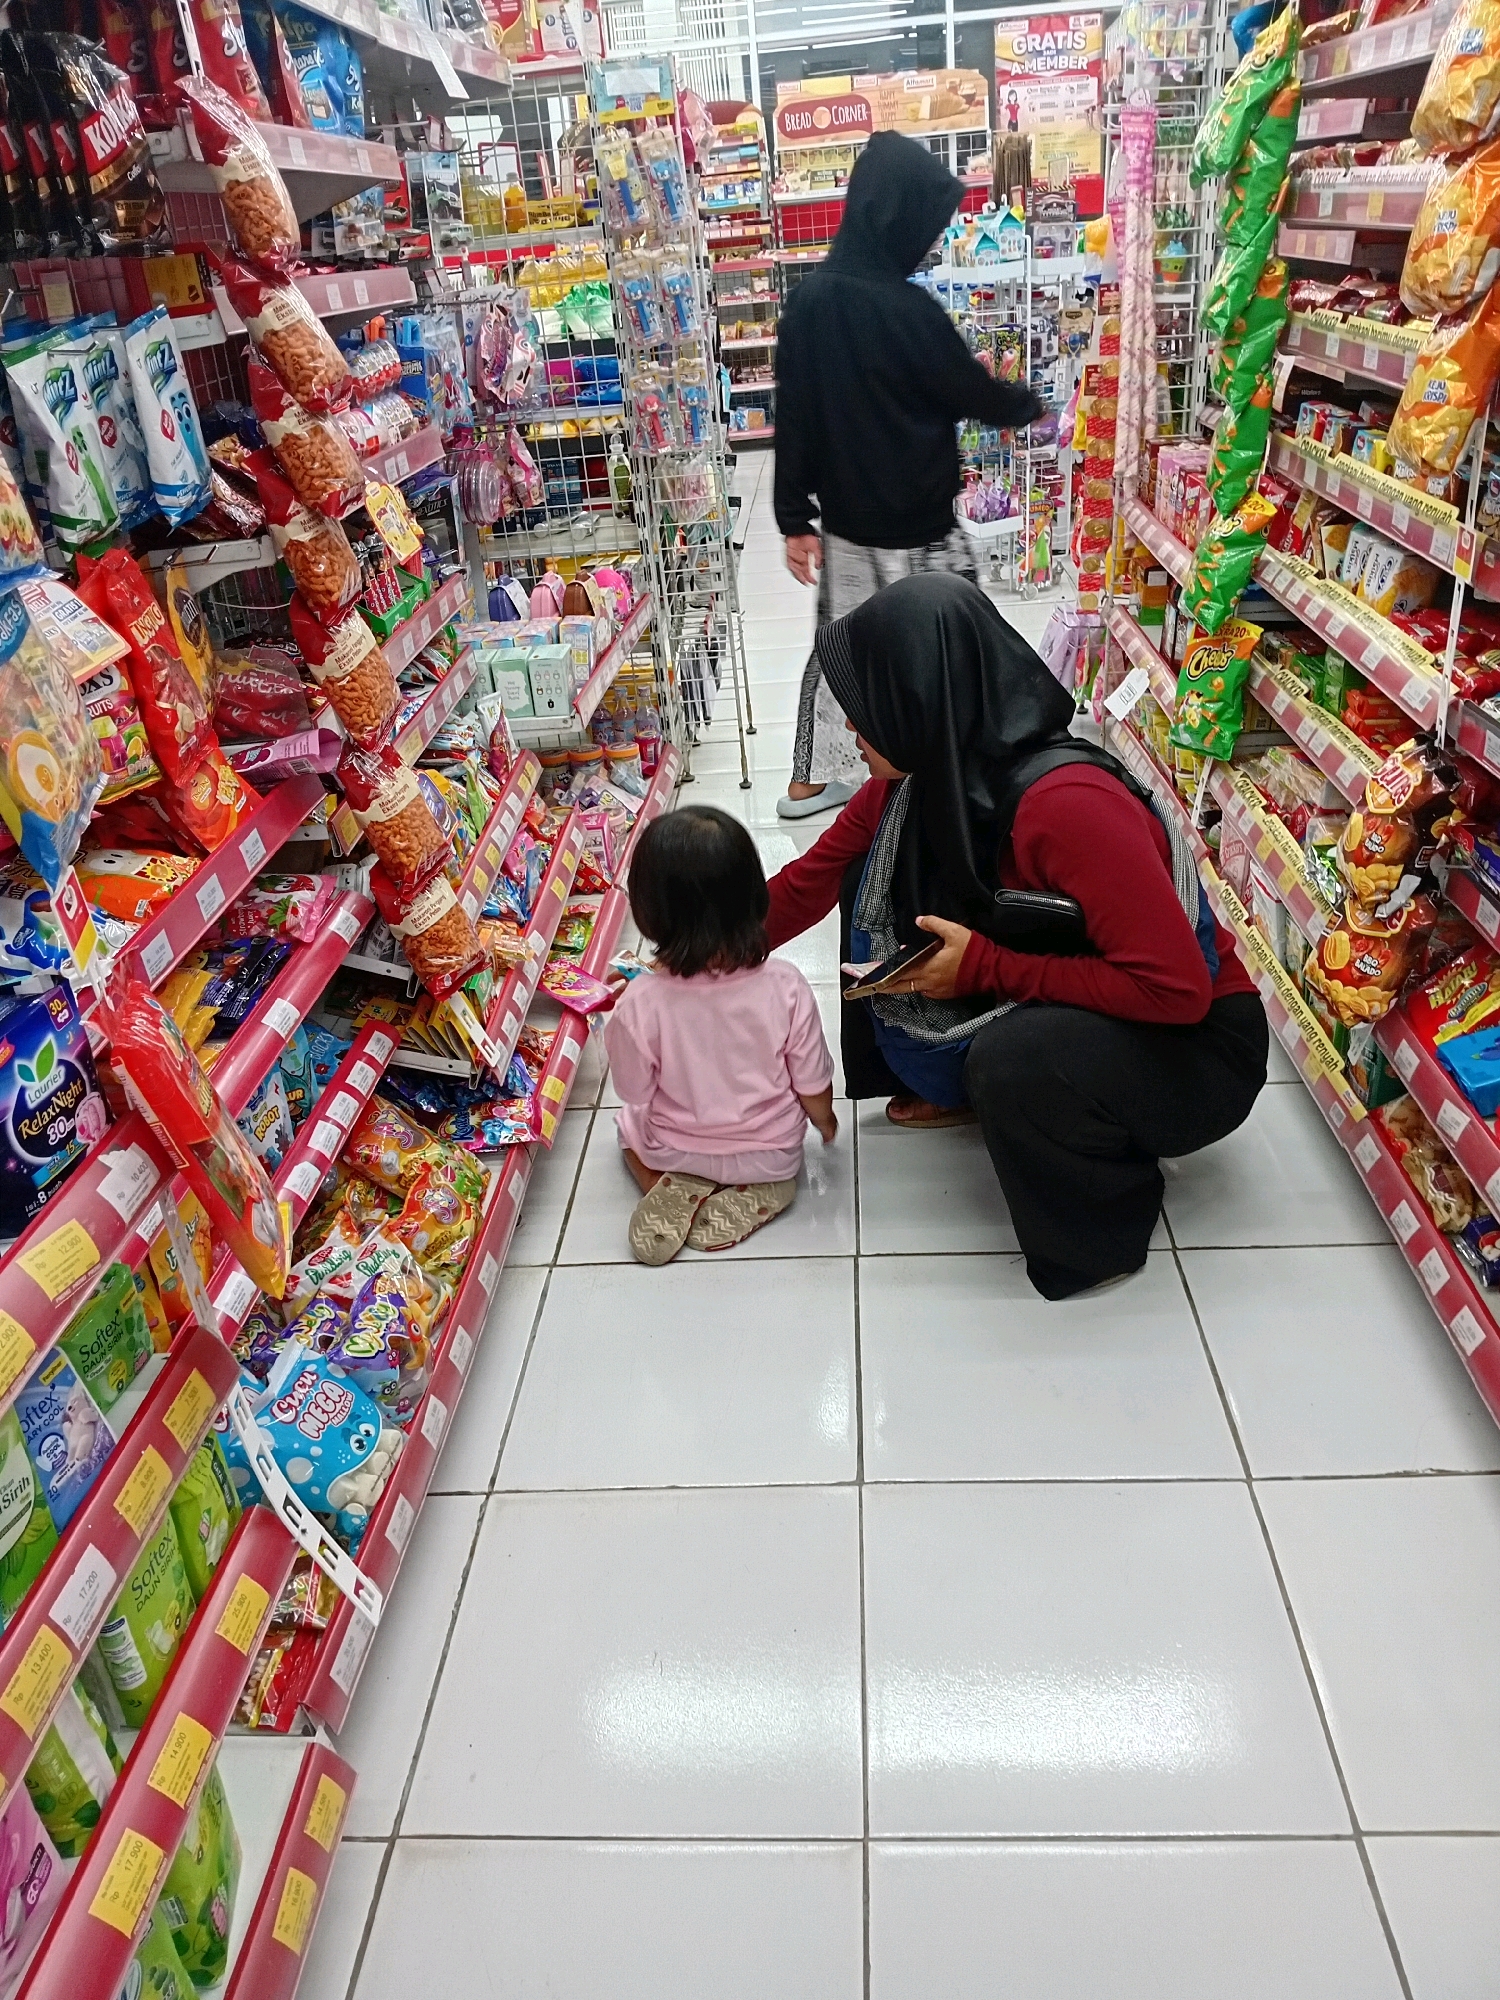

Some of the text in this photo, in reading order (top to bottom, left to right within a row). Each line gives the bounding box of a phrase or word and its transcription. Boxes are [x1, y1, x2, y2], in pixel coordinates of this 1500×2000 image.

[1012, 31, 1087, 56] GRATIS
[784, 103, 868, 132] BREAD CORNER
[1428, 379, 1447, 391] KEJU
[1345, 539, 1361, 575] Malkist
[1365, 552, 1381, 588] Malkist
[53, 599, 78, 621] GRATIS
[334, 646, 354, 666] Makaroni
[338, 655, 354, 671] Ekstra
[1274, 662, 1310, 698] CRACKER
[381, 800, 398, 816] Ekstra
[1234, 778, 1263, 811] CRACKER
[1262, 816, 1286, 848] Lengkapi
[1281, 834, 1303, 867] harimu
[410, 907, 432, 926] Makaroni
[411, 914, 430, 930] Ekstra
[1218, 888, 1245, 925] CRACKER
[1354, 958, 1382, 977] BALADO
[1362, 953, 1379, 967] BBQ
[1427, 960, 1478, 1011] HATARI
[47, 997, 63, 1015] 30
[1245, 929, 1340, 1074] Lengkapi harimu dengan yang renyah
[309, 1030, 335, 1061] BLOCKS
[27, 1068, 63, 1105] Laurier
[47, 1116, 69, 1145] 30
[253, 1105, 281, 1142] ROBOT
[127, 1160, 151, 1184] 10.400
[37, 1190, 48, 1205] 8
[56, 1234, 83, 1256] 12.900
[78, 1308, 121, 1363] Softex
[82, 1351, 106, 1376] DAUN
[44, 1403, 65, 1429] COOL
[296, 1379, 347, 1441] MEGA
[330, 1391, 355, 1428] MALLOW
[2, 1475, 31, 1511] Sirih
[46, 1485, 59, 1499] 20
[131, 1534, 173, 1601] Softex
[61, 1569, 99, 1626] Rp 17.200
[136, 1574, 162, 1613] DAUN
[230, 1592, 249, 1618] 25.900
[12, 1642, 53, 1705] Rp 13.400
[155, 1731, 188, 1787] Rp 14.900
[108, 1839, 145, 1903] Rp 17.900
